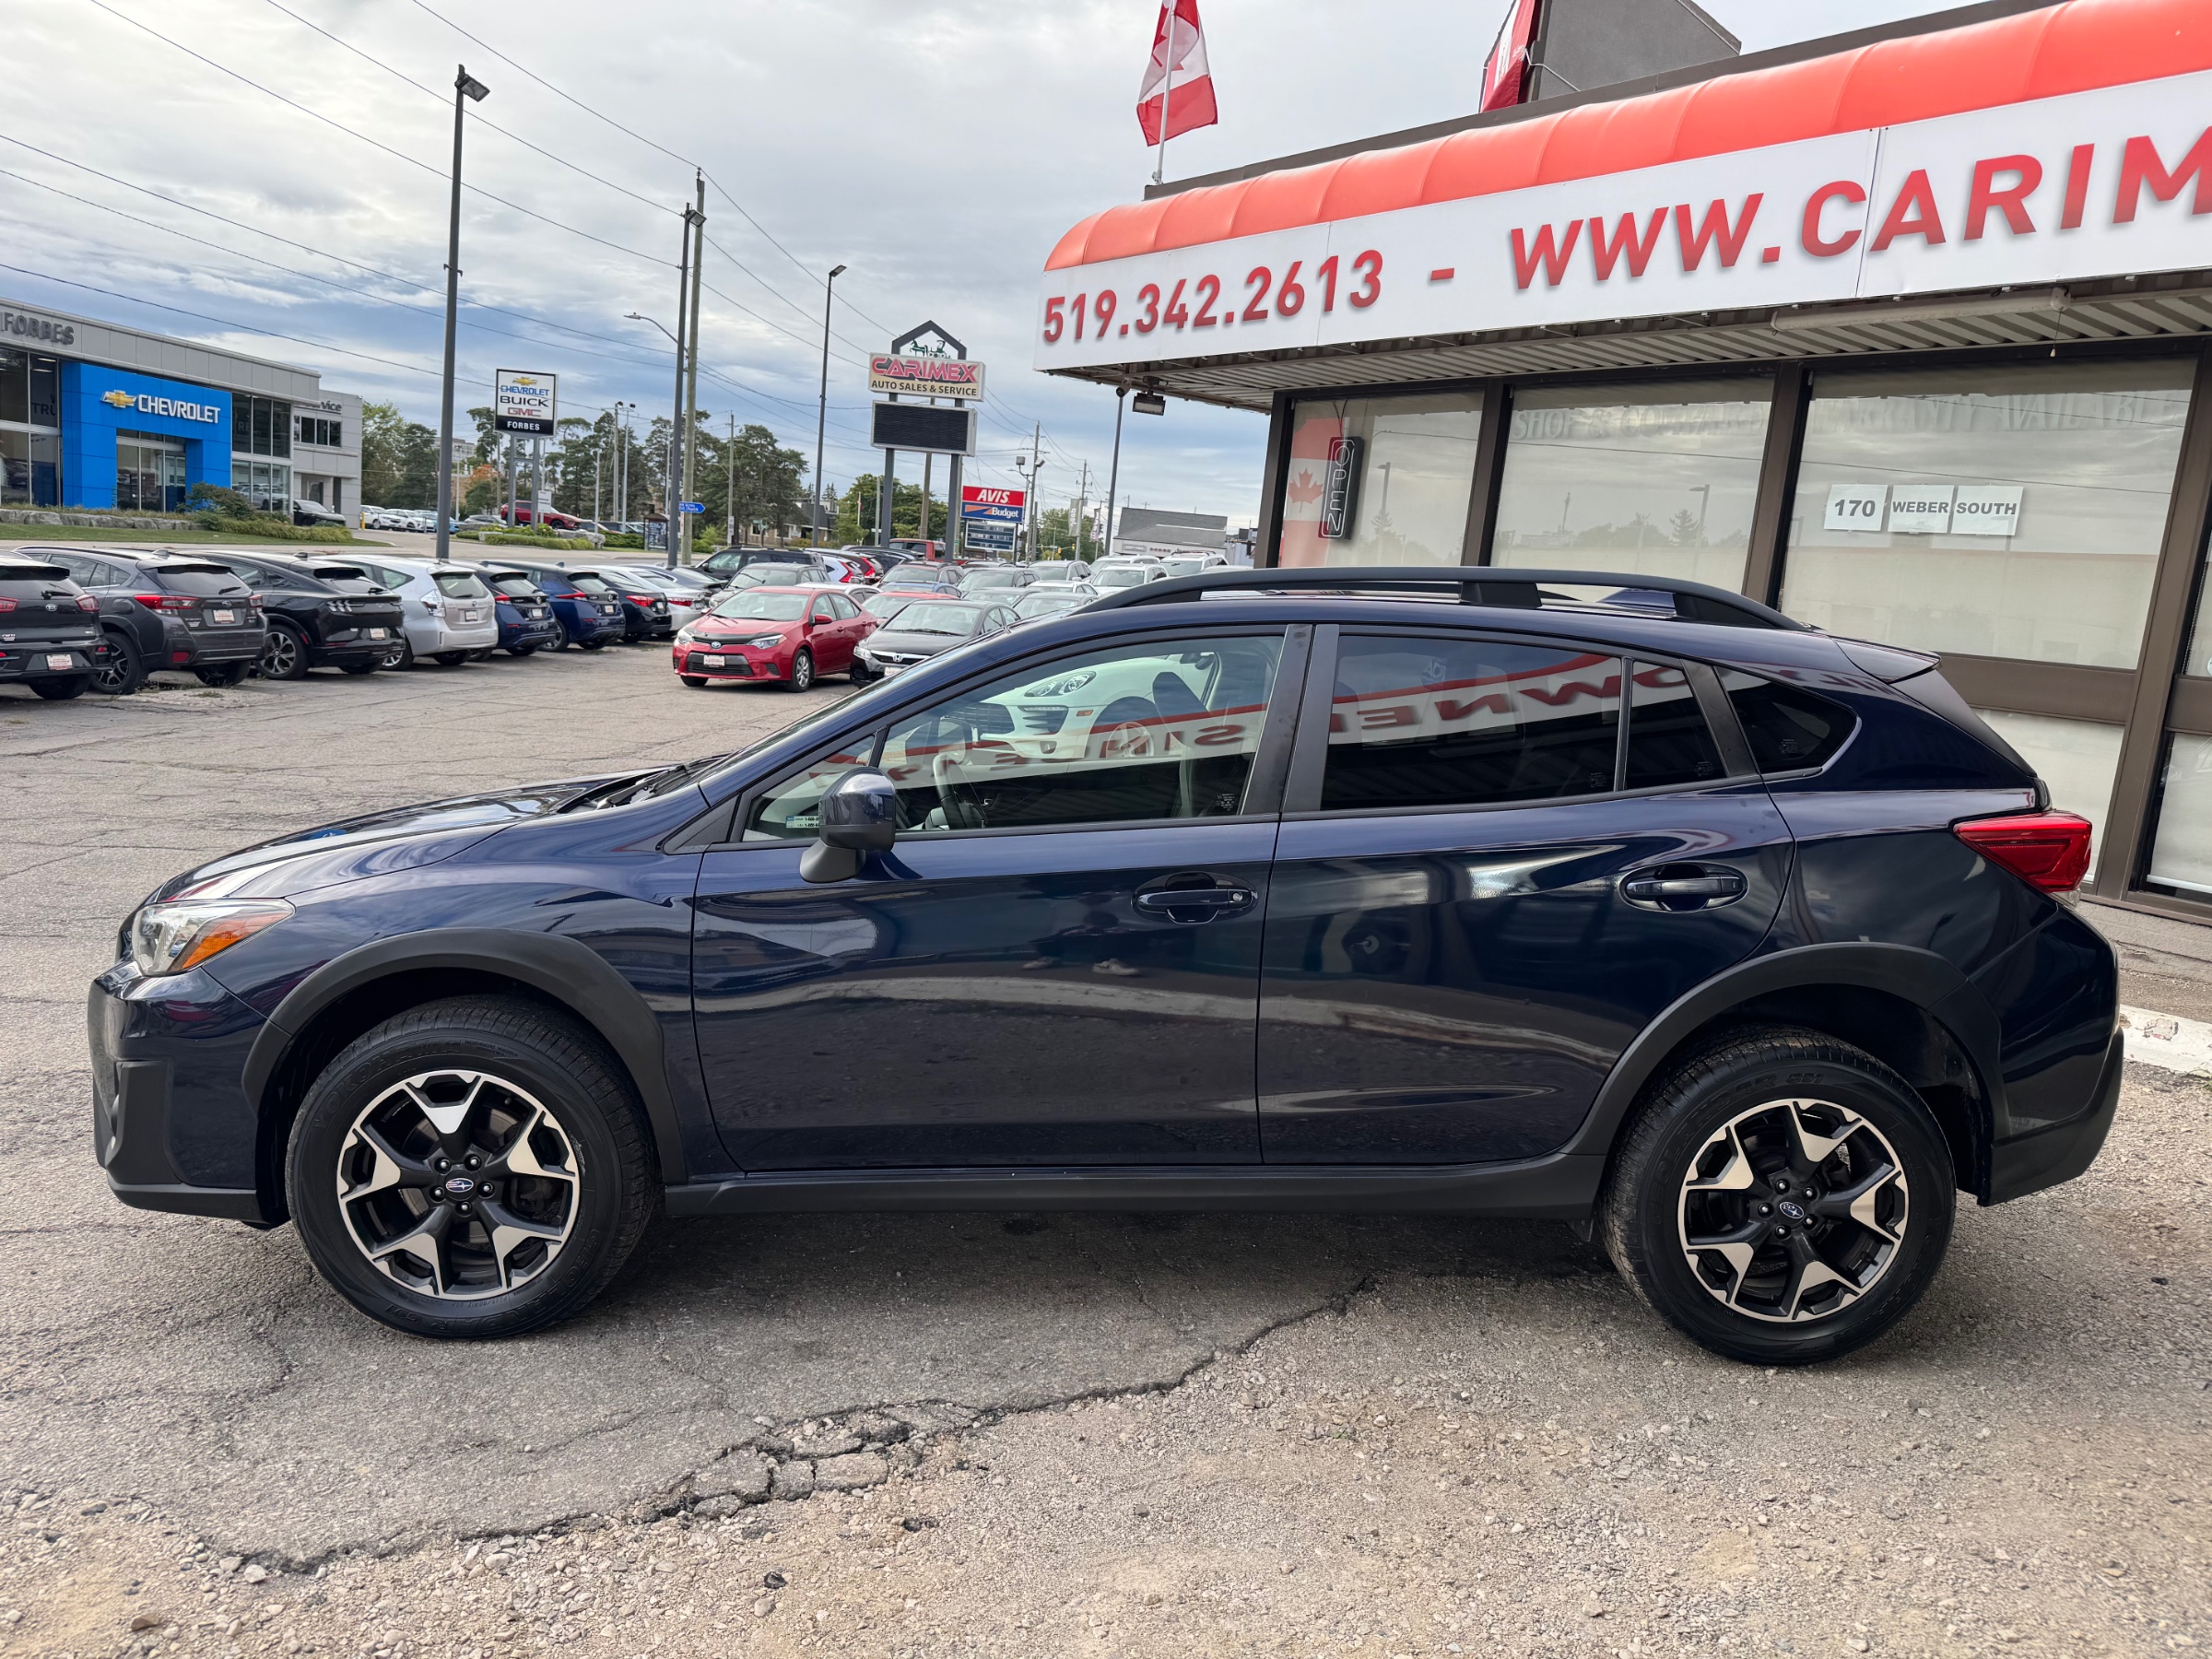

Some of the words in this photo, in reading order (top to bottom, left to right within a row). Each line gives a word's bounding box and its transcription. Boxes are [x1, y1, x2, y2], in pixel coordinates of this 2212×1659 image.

[1043, 249, 1383, 344] 519.342.2613
[5, 312, 75, 345] FORBES
[871, 357, 979, 382] CARIMEX
[501, 385, 549, 395] CHEVROLET
[872, 380, 897, 389] AUTO
[900, 382, 927, 393] SALES
[929, 384, 936, 393] &
[938, 385, 977, 396] SERVICE
[138, 394, 221, 424] CHEVROLET
[500, 396, 549, 407] BUICK
[508, 407, 541, 417] GMC
[507, 421, 540, 430] FORBES
[976, 488, 1010, 504] AVIS
[1326, 445, 1350, 532] OPEN
[992, 507, 1018, 519] Budget
[1834, 499, 1876, 518] 170
[1892, 501, 1949, 513] WEBER
[1956, 502, 2018, 515] SOUTH
